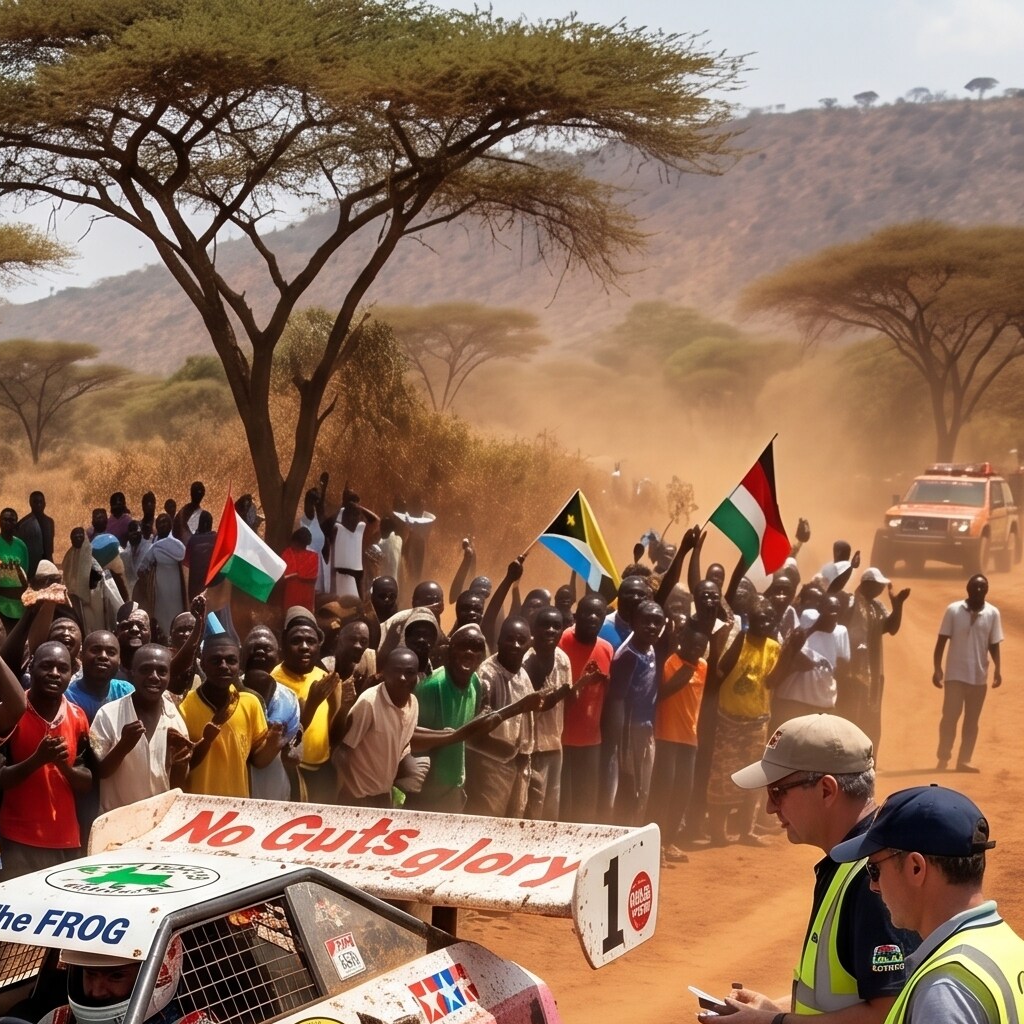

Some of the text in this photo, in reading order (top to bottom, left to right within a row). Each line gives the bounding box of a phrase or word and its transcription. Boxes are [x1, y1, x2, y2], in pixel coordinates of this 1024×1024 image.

[161, 810, 581, 887] No Guts glory
[33, 909, 130, 945] FROG
[602, 856, 624, 955] 1
